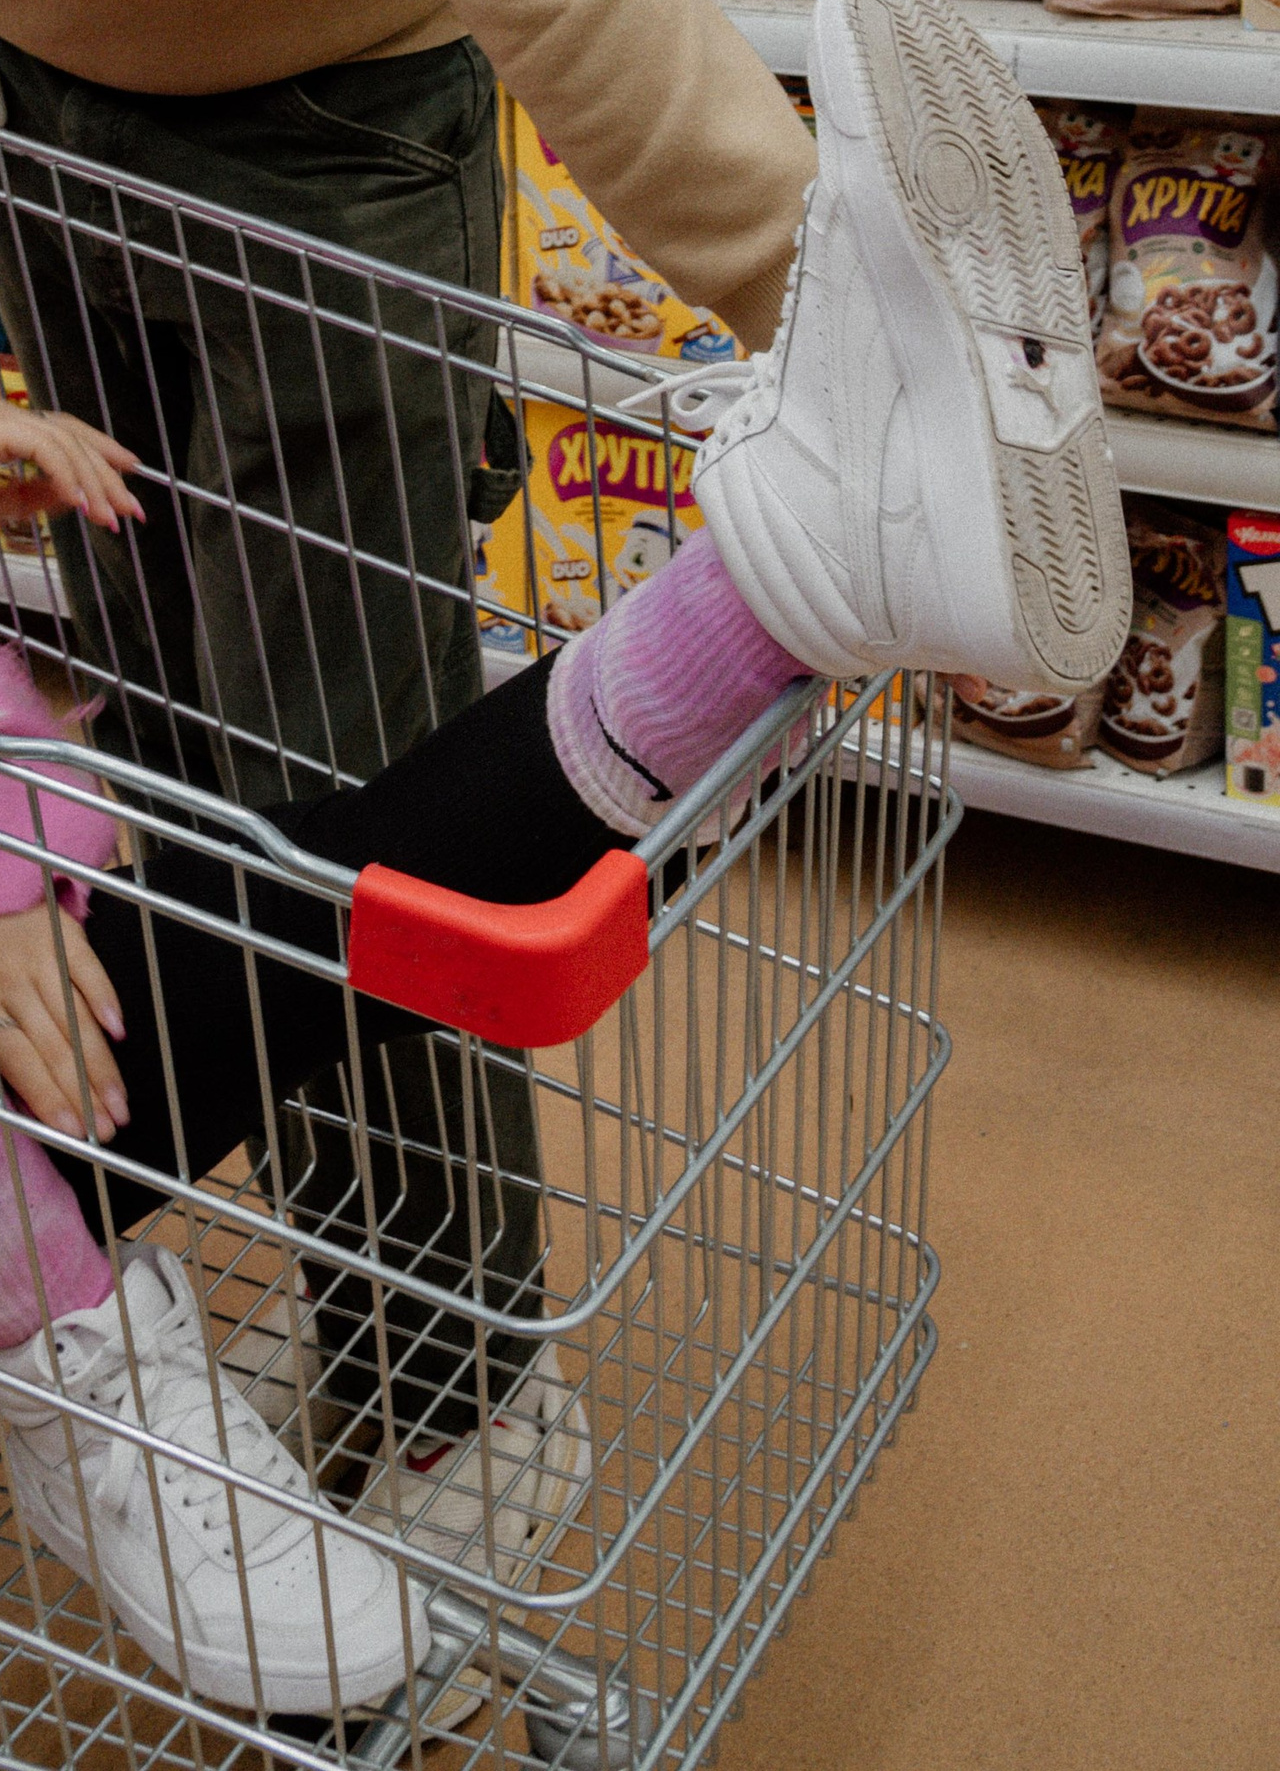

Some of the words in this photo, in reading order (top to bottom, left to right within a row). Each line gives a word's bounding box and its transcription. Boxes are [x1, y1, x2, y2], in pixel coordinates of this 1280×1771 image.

[1127, 176, 1246, 233] ХРУТКА
[540, 229, 579, 250] DUO
[551, 561, 591, 580] DUO
